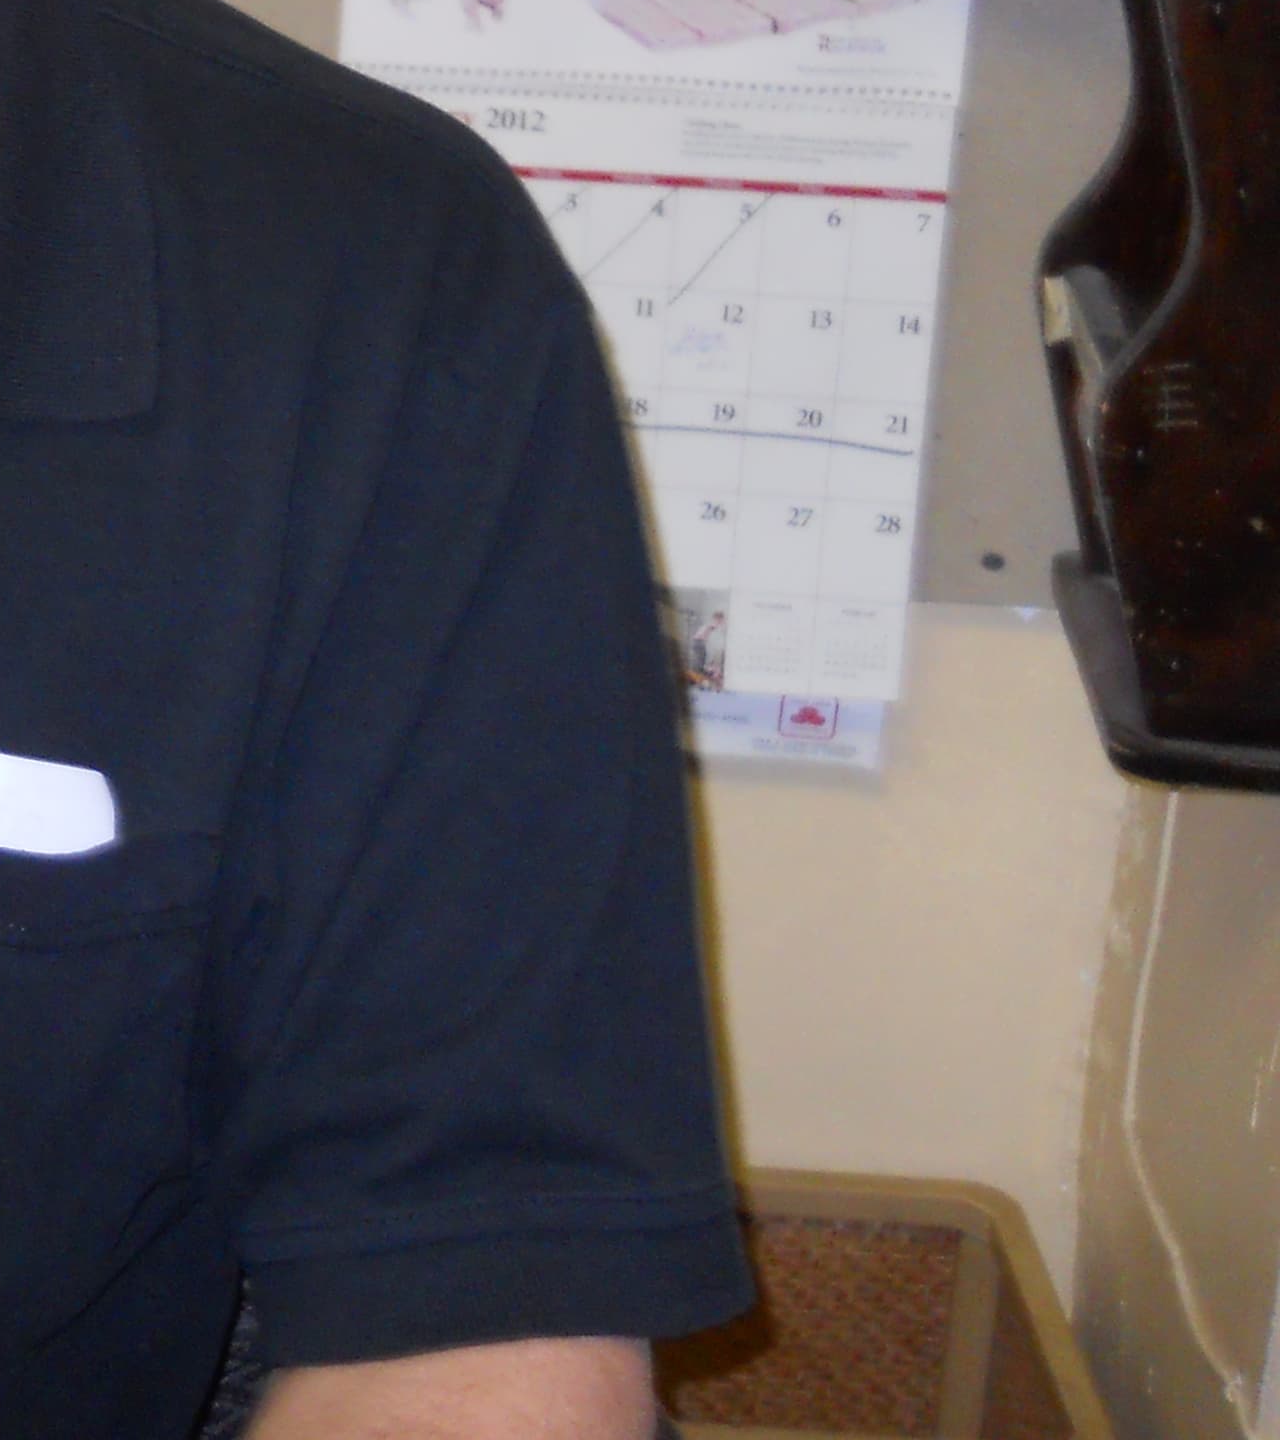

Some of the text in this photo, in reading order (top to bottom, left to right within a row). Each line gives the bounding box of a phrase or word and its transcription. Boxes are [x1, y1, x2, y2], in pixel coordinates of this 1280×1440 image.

[486, 109, 547, 133] 2012
[565, 193, 931, 232] 3 4 5 6 7
[636, 299, 921, 335] 11 12 13 14
[627, 398, 909, 435] 18 19 20 21
[700, 502, 901, 535] 26 27 28
